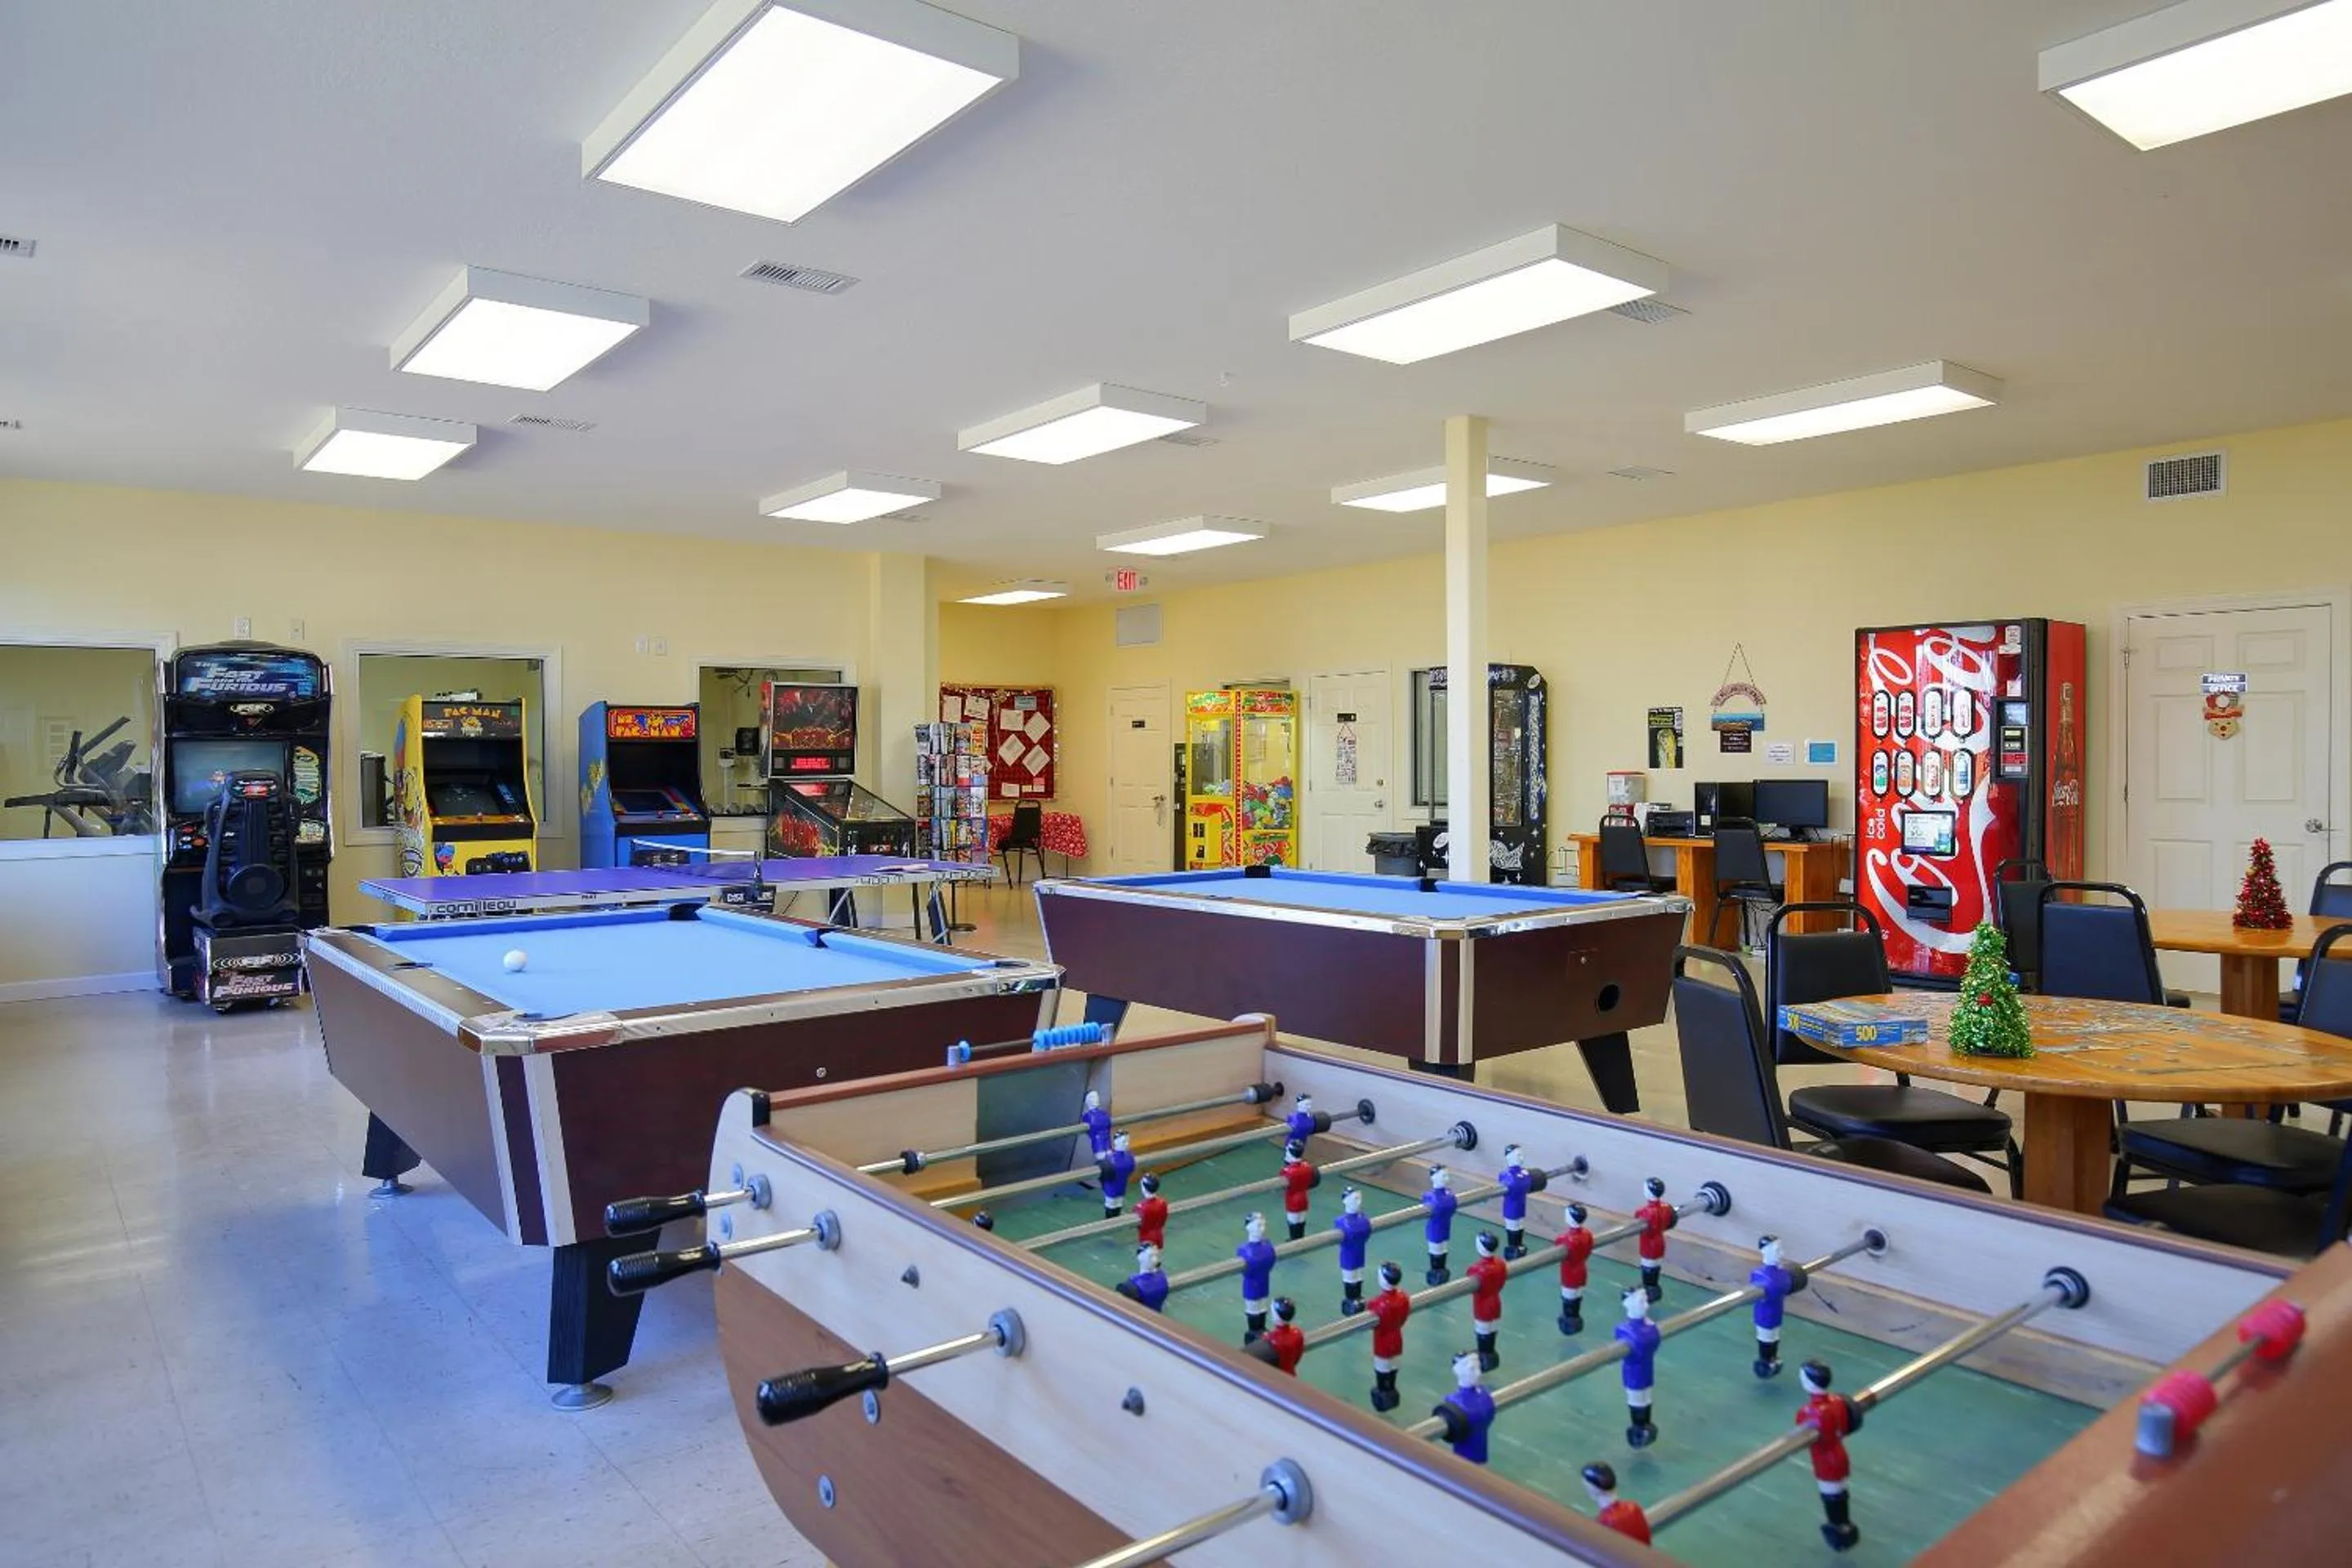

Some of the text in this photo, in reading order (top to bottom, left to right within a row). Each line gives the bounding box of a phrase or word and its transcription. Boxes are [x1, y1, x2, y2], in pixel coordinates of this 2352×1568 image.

[1117, 572, 1136, 590] EXIT
[1875, 808, 1886, 840] cold
[1786, 1012, 1800, 1031] 500
[1855, 1025, 1878, 1041] 500
